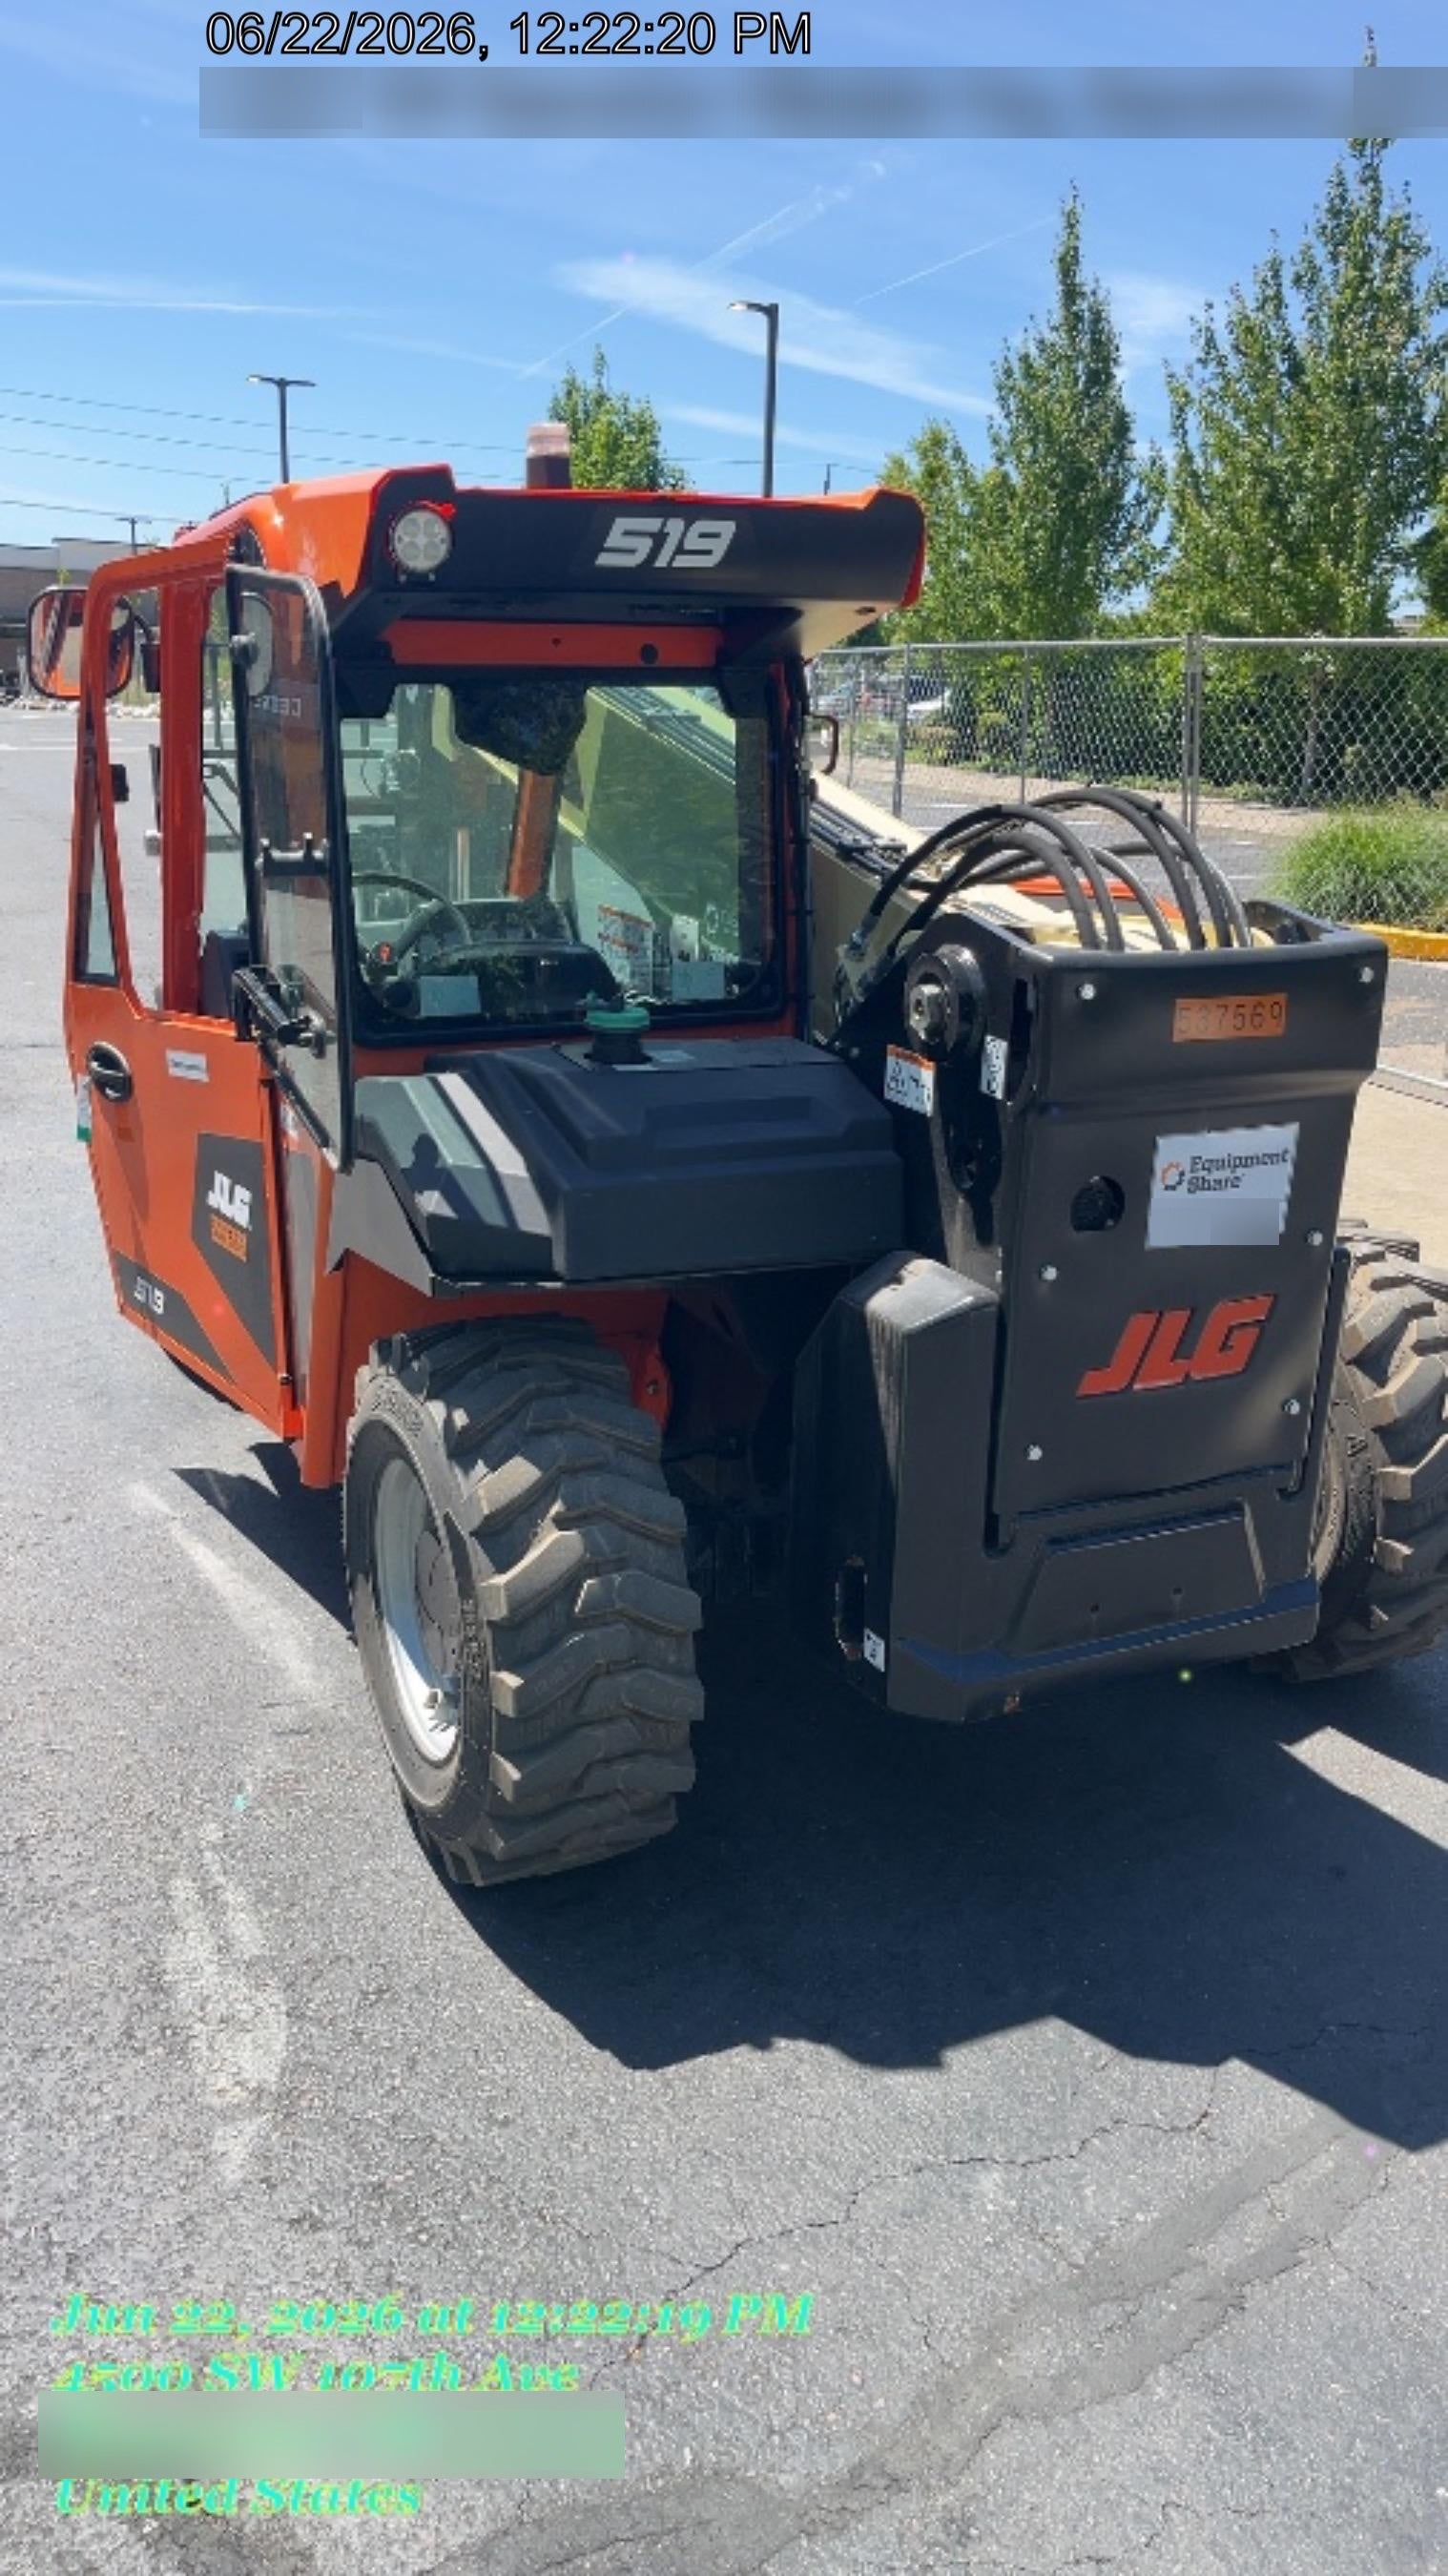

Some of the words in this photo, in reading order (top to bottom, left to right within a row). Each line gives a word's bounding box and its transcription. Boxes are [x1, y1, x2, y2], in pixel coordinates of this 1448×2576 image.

[594, 517, 736, 568] 519
[1187, 1174, 1242, 1195] Share
[1189, 1148, 1290, 1174] Equipment
[205, 1170, 252, 1231] JLG
[1075, 1293, 1276, 1400] JLG
